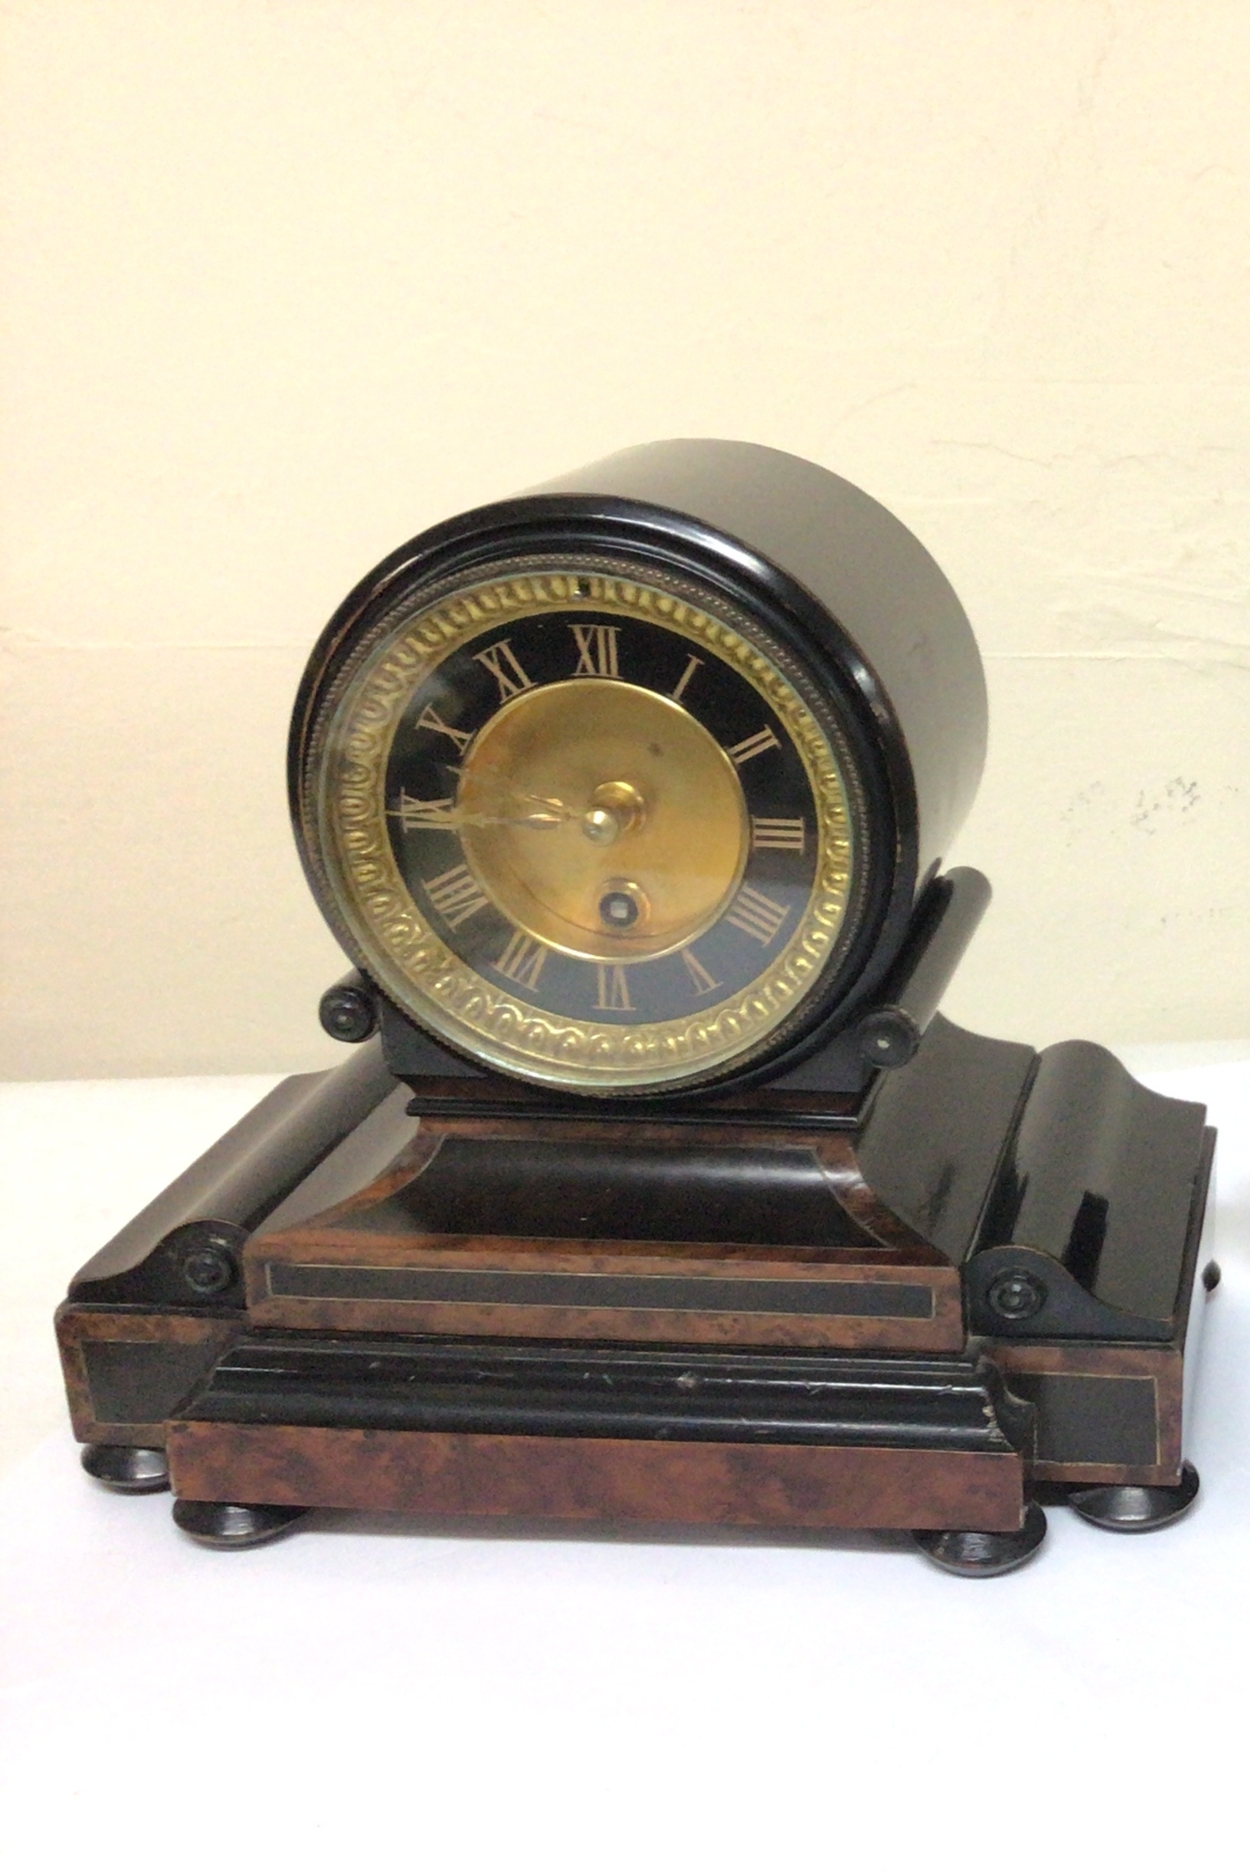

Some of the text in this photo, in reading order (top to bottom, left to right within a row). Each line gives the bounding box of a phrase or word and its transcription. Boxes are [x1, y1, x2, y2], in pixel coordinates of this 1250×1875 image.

[472, 639, 538, 704] XI
[567, 624, 623, 679] XII
[666, 653, 705, 704] I
[414, 702, 477, 756] X
[726, 724, 782, 765] II
[752, 815, 804, 855] III
[420, 863, 489, 934] VIII
[725, 881, 791, 948] IIII
[490, 930, 548, 993] VII
[593, 964, 636, 1011] VI
[679, 949, 724, 996] V
